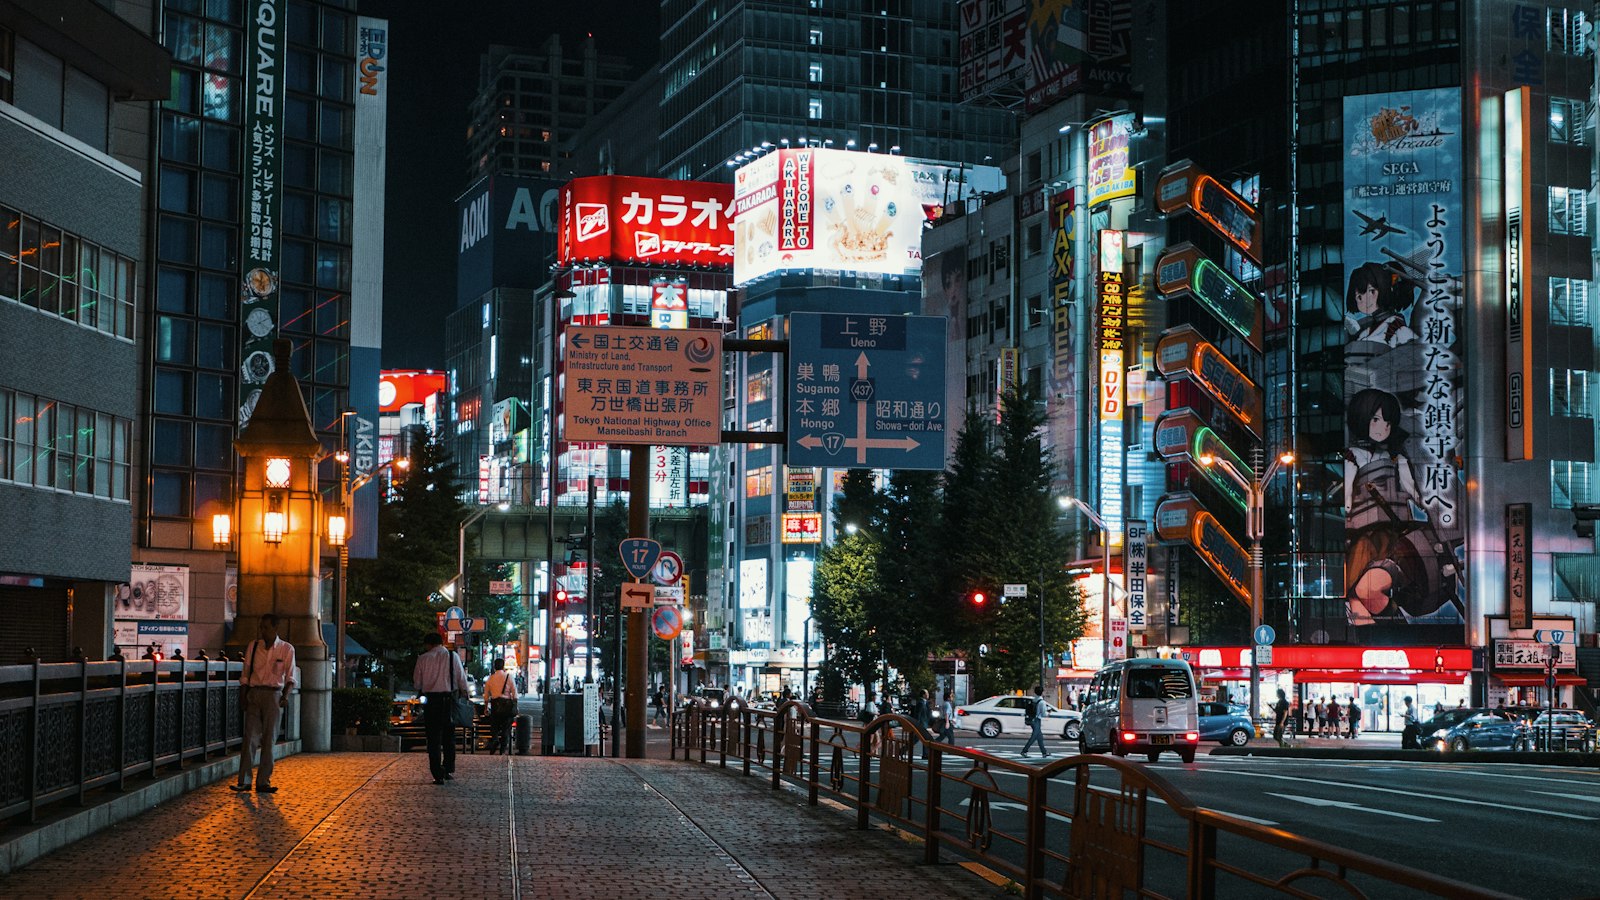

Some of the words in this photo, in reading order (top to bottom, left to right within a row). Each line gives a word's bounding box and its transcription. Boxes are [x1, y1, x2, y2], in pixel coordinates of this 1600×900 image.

[1512, 5, 1542, 85] 保全
[256, 0, 276, 117] QUARE
[1380, 136, 1444, 150] Arcade
[912, 170, 934, 180] TAX
[1383, 162, 1419, 175] SEGA
[250, 120, 263, 260] 人気ブランド多数取り揃え
[262, 123, 275, 262] メンズ・レディース腕時計
[799, 154, 808, 221] WELCOME
[736, 184, 777, 213] TAKARADA
[784, 160, 793, 247] AKIHABARA
[460, 190, 489, 254] AOKI
[799, 228, 808, 246] TO
[1054, 202, 1070, 279] TAX
[1103, 272, 1121, 282] ゲーム
[1104, 283, 1120, 293] CD
[656, 284, 684, 308] 本
[1102, 306, 1122, 316] アニメ
[840, 317, 887, 336] 上野
[1054, 282, 1069, 381] FREE
[593, 334, 680, 351] 国土交通省
[850, 337, 876, 348] Ueno
[569, 351, 598, 361] Ministry
[601, 351, 609, 360] of
[1425, 204, 1453, 523] ようこそ新たな鎮守府へ。
[569, 361, 619, 371] Infrastructure
[621, 363, 635, 371] and
[638, 363, 673, 373] Transport
[796, 362, 841, 382] 巣鴨
[577, 378, 709, 396] 東京国道事務所
[796, 383, 840, 395] Sugamo
[854, 385, 870, 396] 437
[1105, 371, 1118, 413] DVD
[591, 396, 694, 413] 万世橋出張所
[795, 398, 840, 417] 本郷
[876, 400, 941, 419] 昭和通り
[573, 415, 600, 426] Tokyo
[603, 416, 640, 426] National
[643, 417, 681, 428] Highway
[685, 418, 712, 427] Office
[800, 418, 835, 430] Hongo
[875, 419, 924, 431] Showa-dori
[927, 422, 944, 432] Ave.
[597, 427, 653, 436] Manseibashi
[656, 427, 687, 437] Branch
[826, 436, 839, 449] 17
[1129, 527, 1146, 538] 8F
[631, 549, 649, 563] 17
[461, 619, 471, 629] 17
[1553, 632, 1562, 641] 17
[1515, 650, 1563, 664] 元祖
